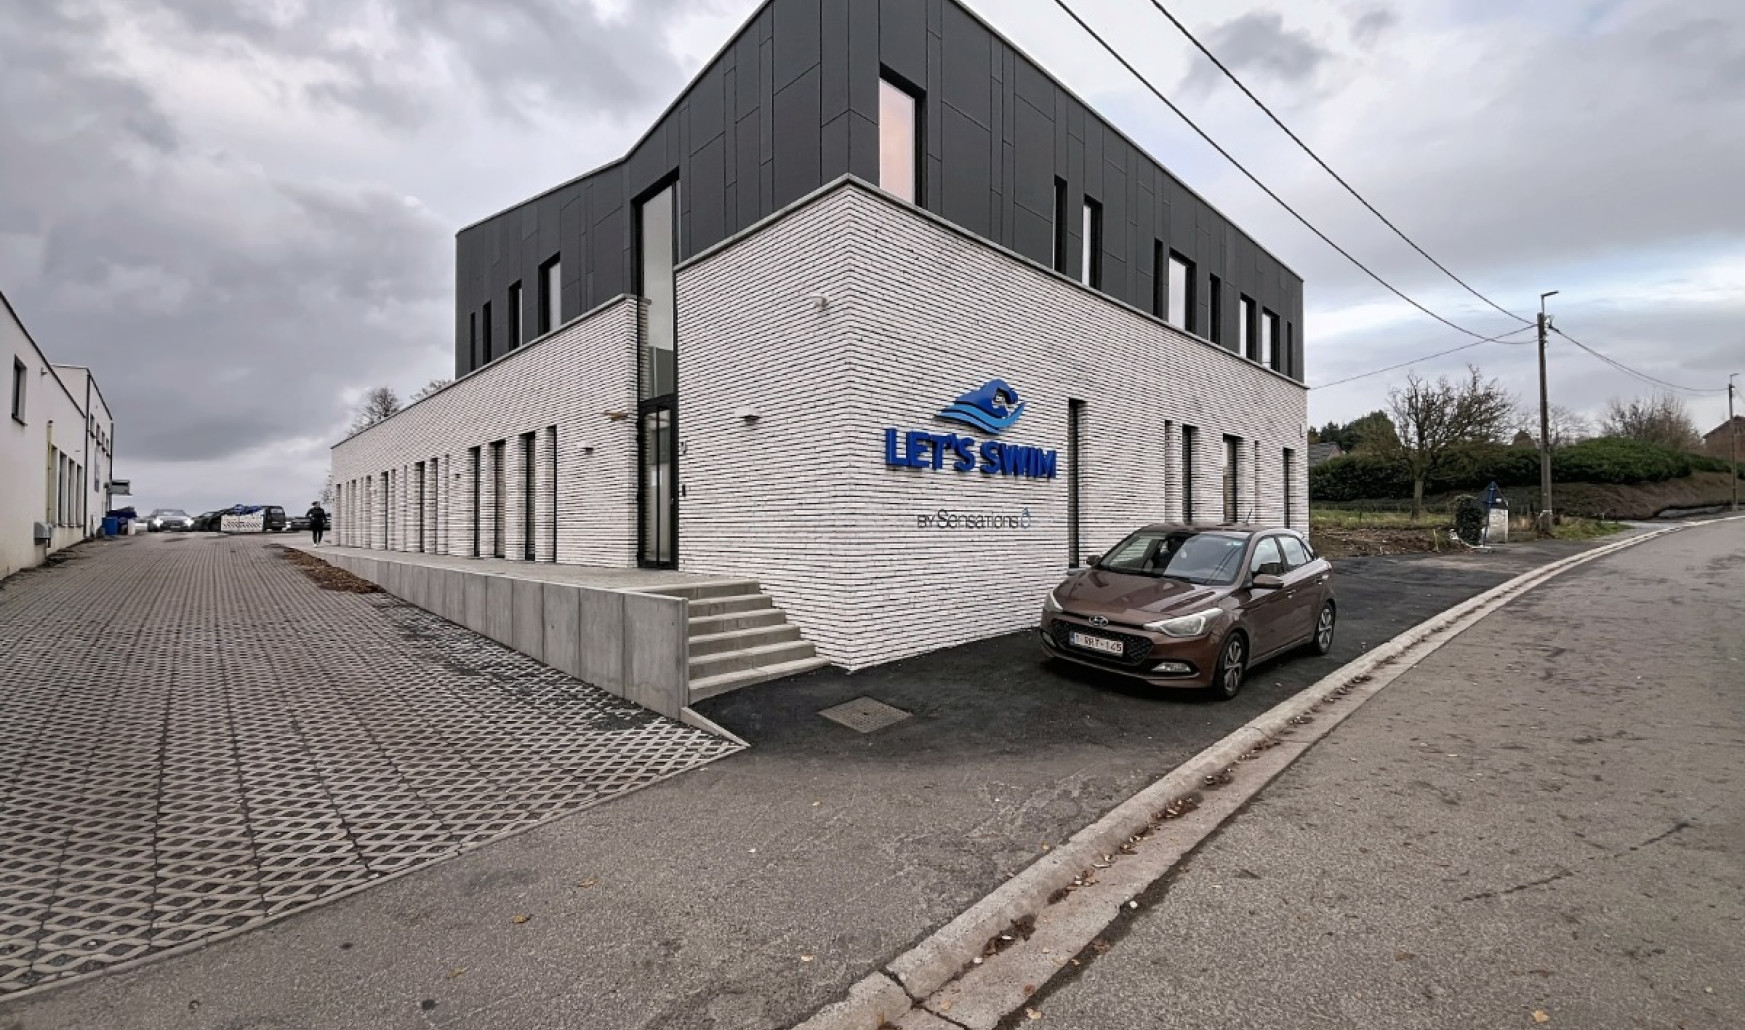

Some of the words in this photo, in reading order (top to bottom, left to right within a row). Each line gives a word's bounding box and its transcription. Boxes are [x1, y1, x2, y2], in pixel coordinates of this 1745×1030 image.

[885, 427, 975, 472] LET'S
[979, 441, 1057, 479] SWIM
[917, 514, 935, 528] BY
